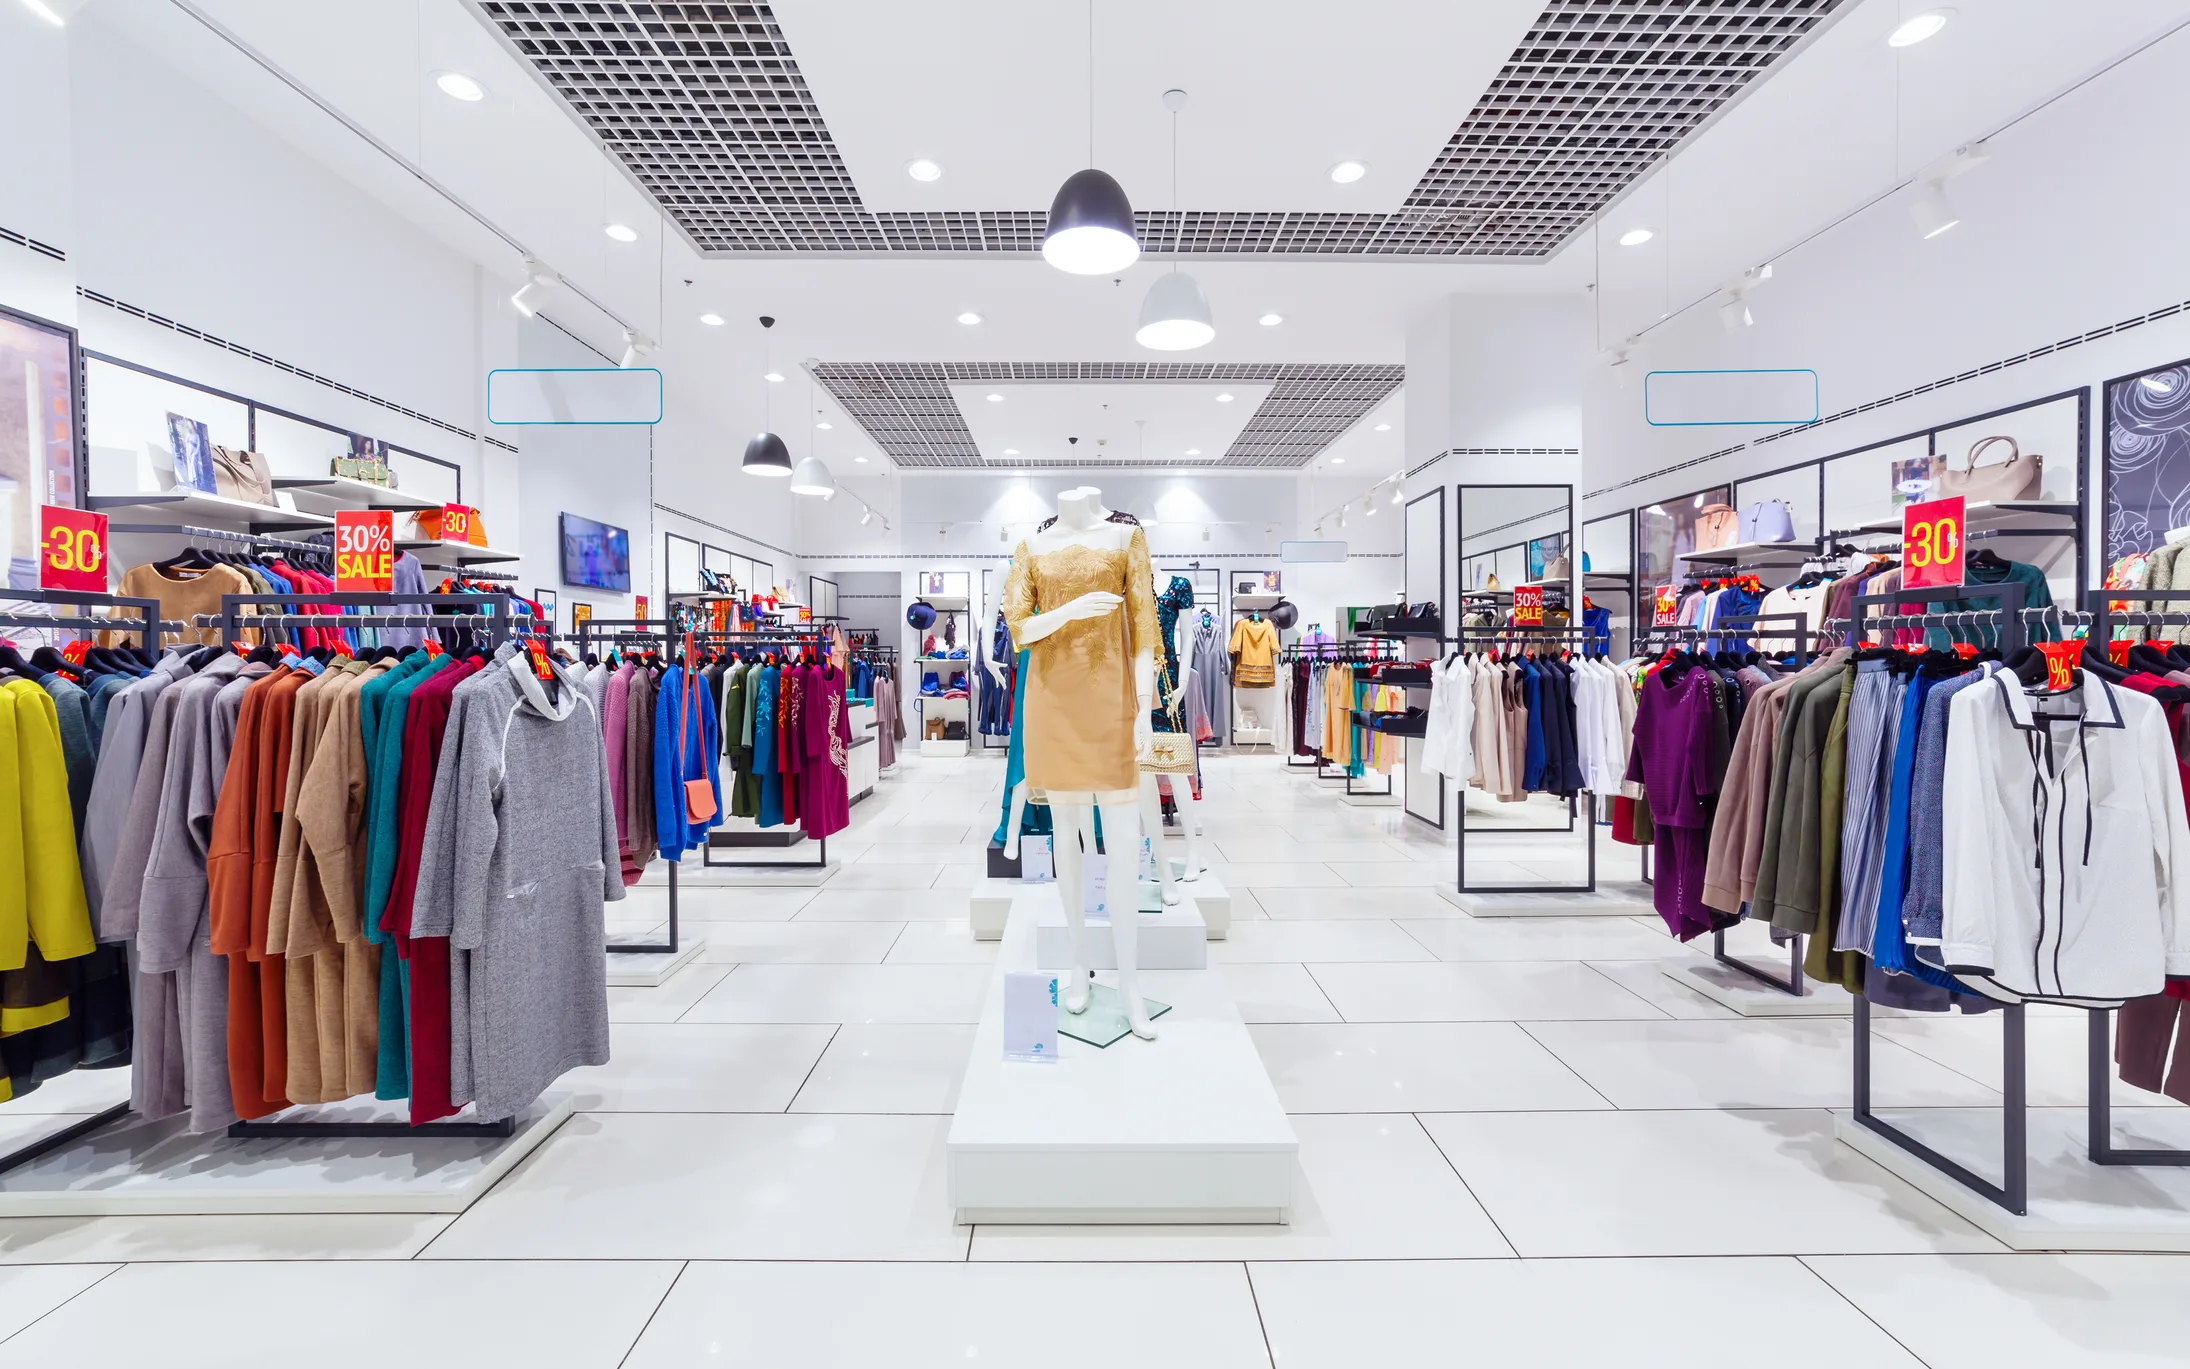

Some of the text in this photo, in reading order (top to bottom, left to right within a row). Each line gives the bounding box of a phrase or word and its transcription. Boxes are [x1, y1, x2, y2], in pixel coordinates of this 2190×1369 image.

[338, 525, 391, 552] 30%
[338, 554, 392, 578] SALE
[1516, 593, 1541, 607] 30%
[1515, 607, 1542, 619] SALE
[1657, 613, 1675, 625] SALE
[534, 653, 551, 675] %
[2049, 656, 2070, 686] %
